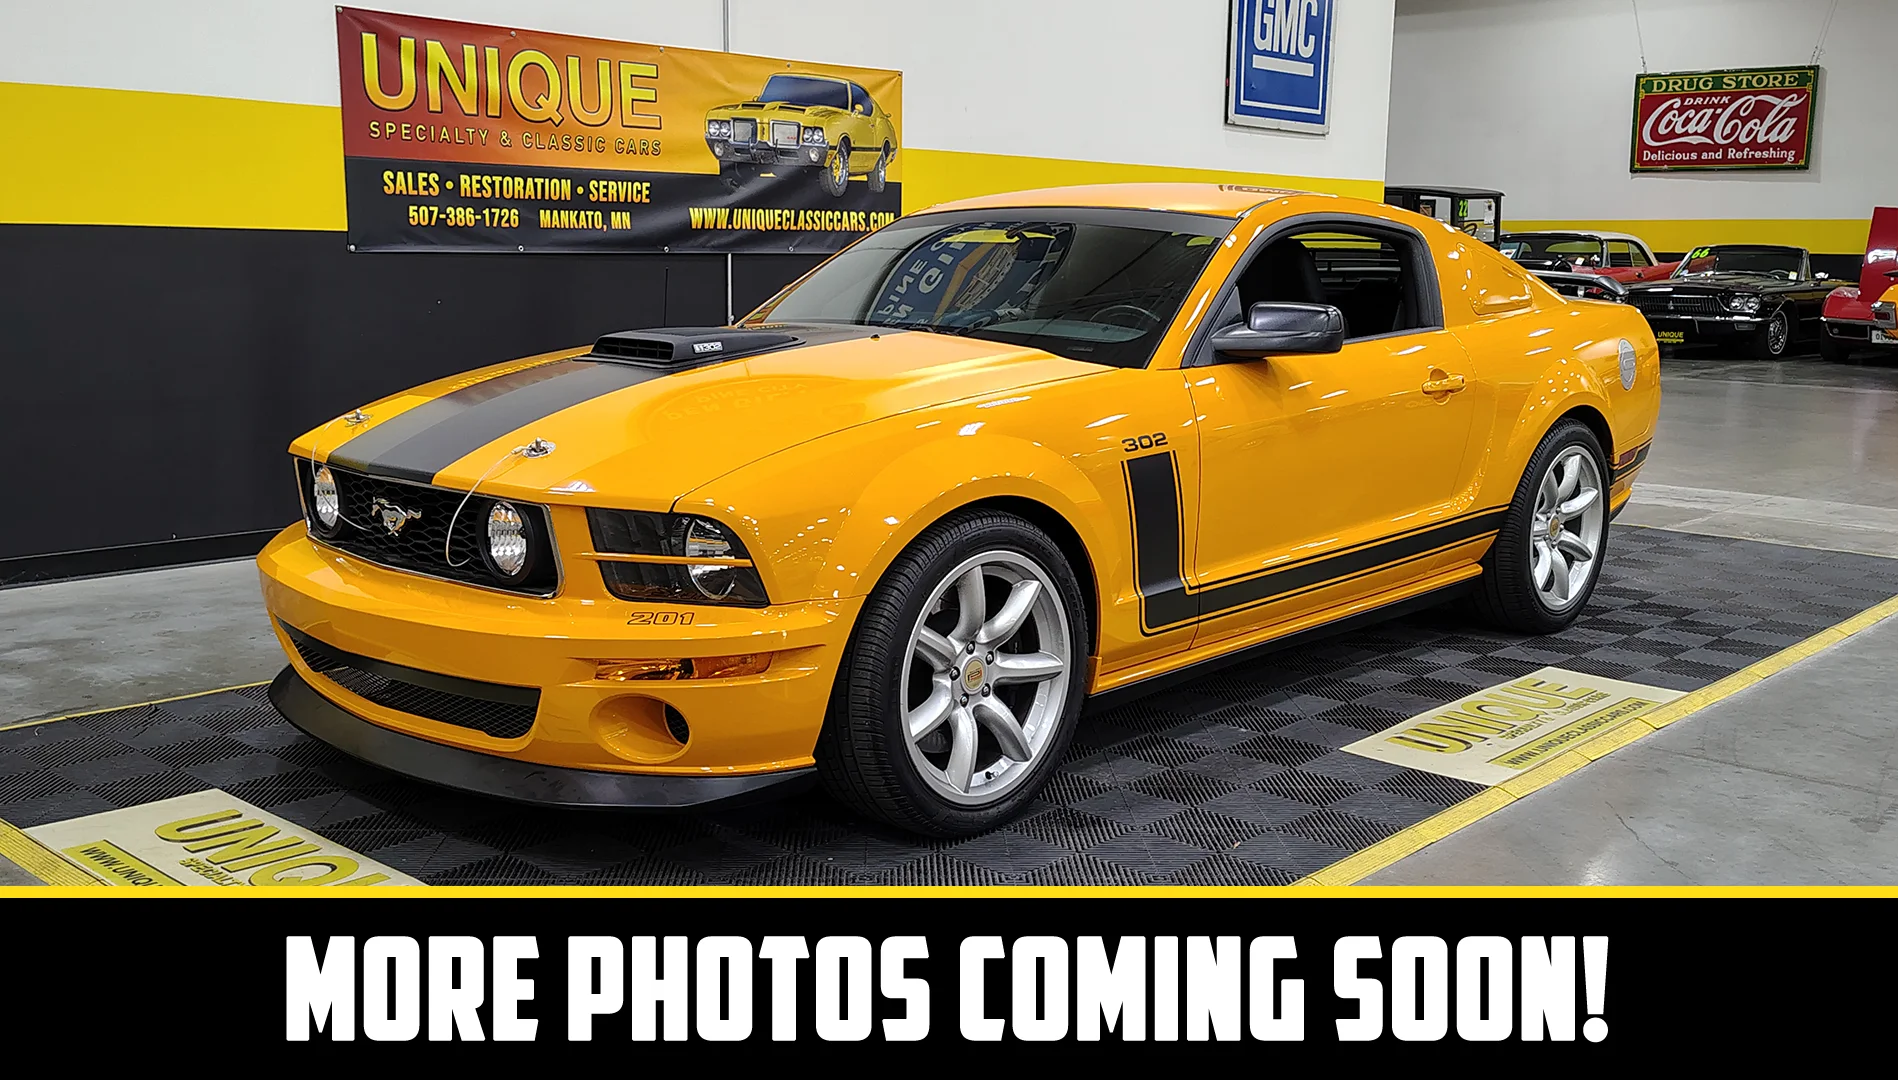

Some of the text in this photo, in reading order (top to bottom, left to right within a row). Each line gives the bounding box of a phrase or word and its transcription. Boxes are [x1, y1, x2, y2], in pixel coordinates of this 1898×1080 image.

[1253, 0, 1318, 58] GMC
[361, 31, 662, 130] UNIQUE
[1652, 73, 1799, 93] DRUG STORE
[1683, 95, 1731, 106] DRINK
[1642, 93, 1807, 147] Coca-Cola
[368, 120, 662, 156] SPECIALTY & CLASSIC CARS
[1643, 147, 1796, 163] Delicious and Refreshing
[383, 170, 651, 204] SALES RESTORATION SERVICE
[408, 205, 632, 232] 507-386-1726 MANKATO, MN
[689, 207, 895, 232] WWW.UNIQUECLASSICCARS.COM
[1458, 200, 1468, 217] 22
[1691, 247, 1711, 259] 66
[1657, 331, 1684, 339] UNIQUE
[1121, 432, 1169, 453] 302
[627, 611, 695, 626] 201
[1384, 677, 1598, 755] UNIQUE
